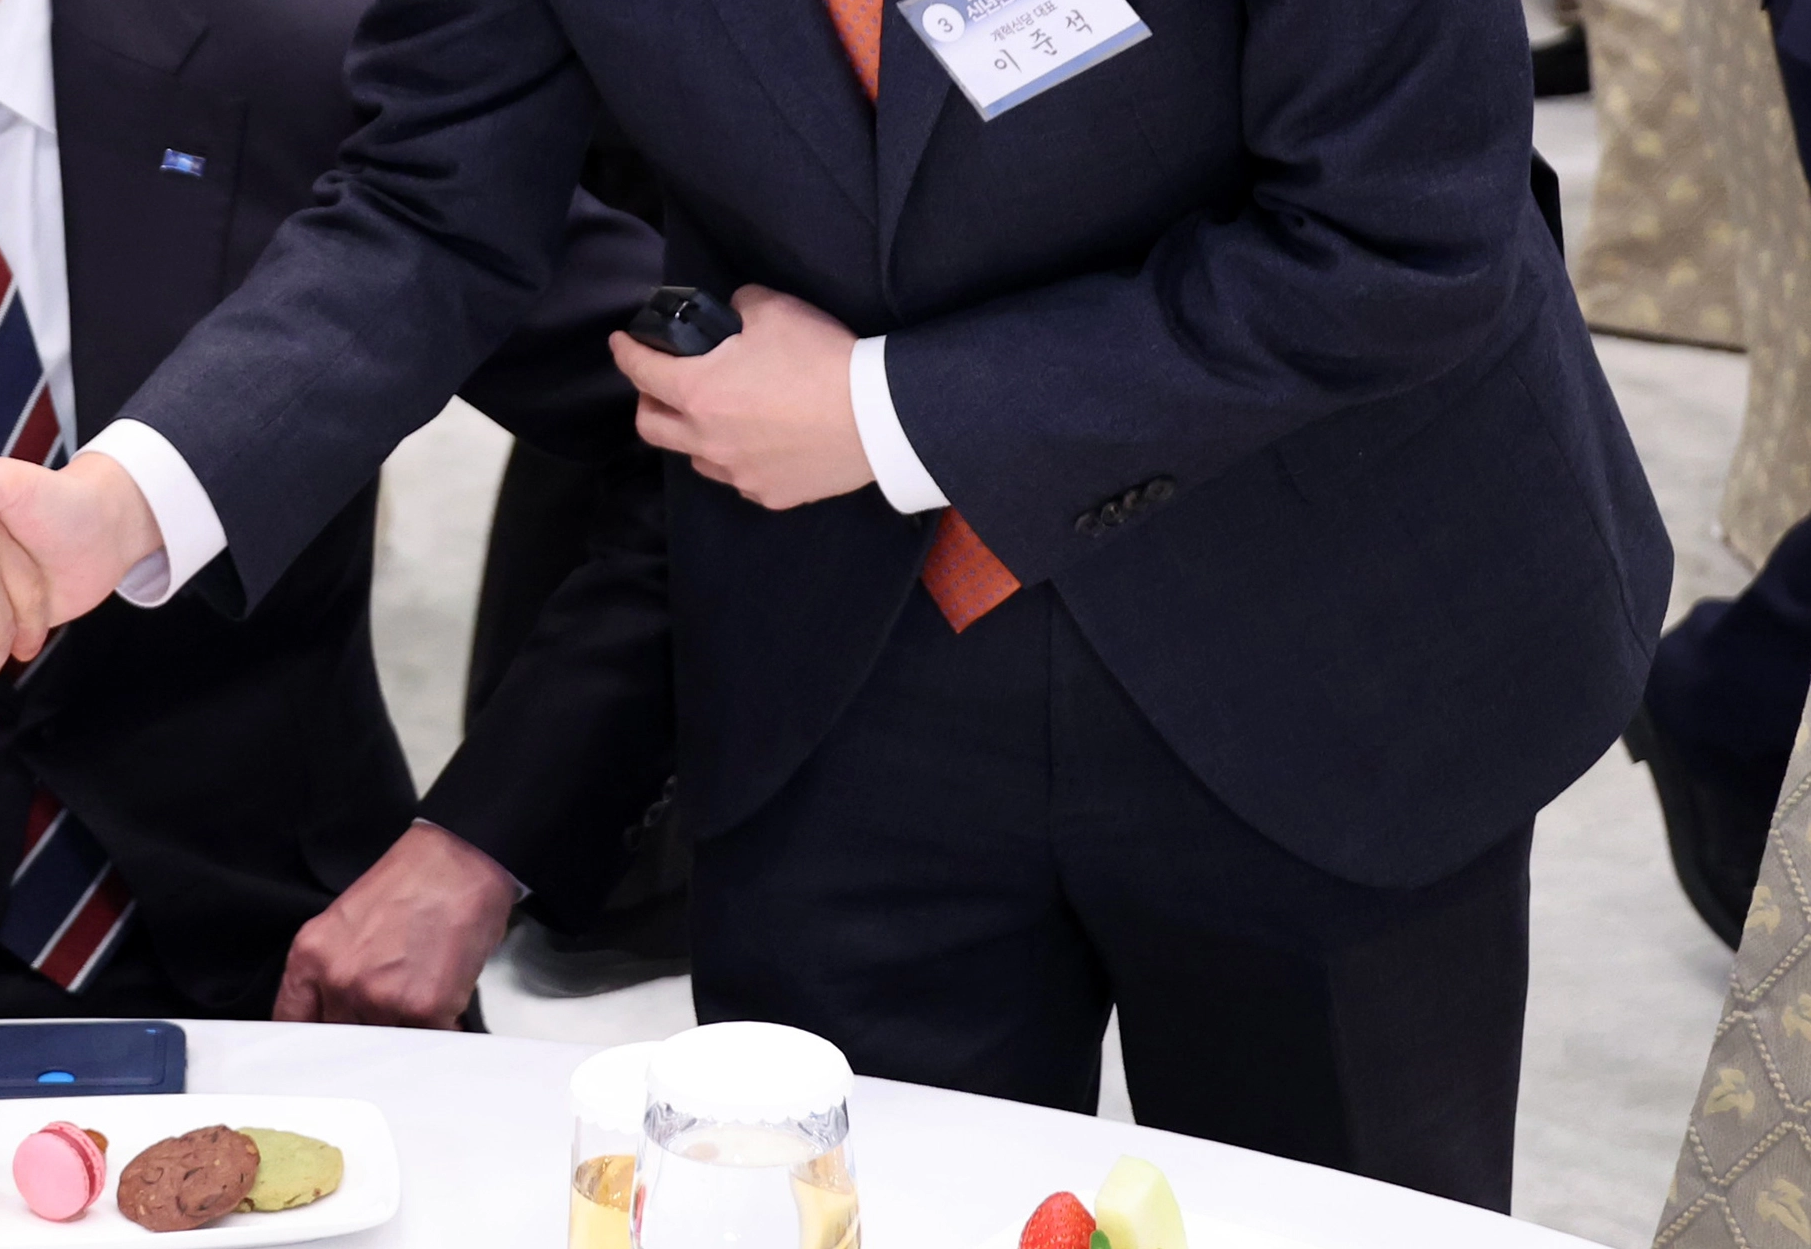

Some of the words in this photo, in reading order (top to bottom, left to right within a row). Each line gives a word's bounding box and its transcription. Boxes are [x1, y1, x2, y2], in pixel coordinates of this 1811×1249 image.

[937, 17, 953, 33] 3
[991, 13, 1035, 42] 개혁신당
[1033, 0, 1058, 18] 대표
